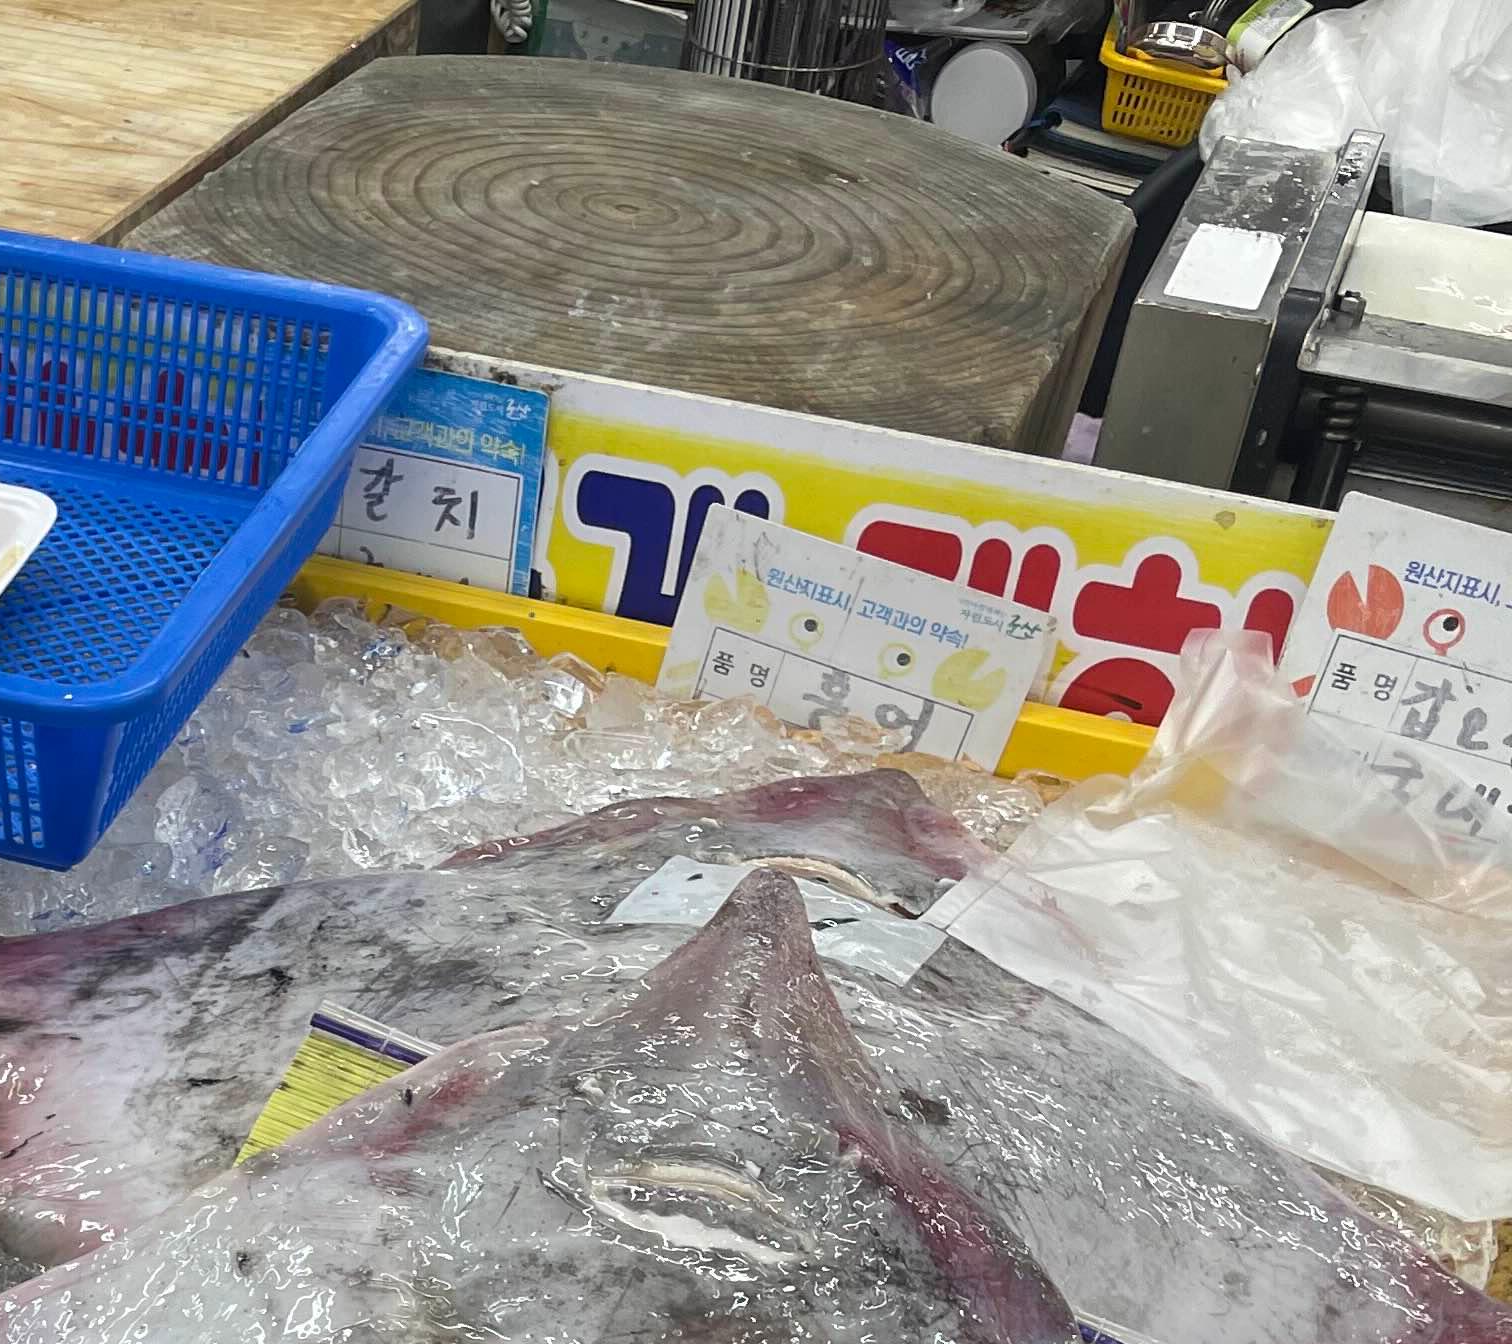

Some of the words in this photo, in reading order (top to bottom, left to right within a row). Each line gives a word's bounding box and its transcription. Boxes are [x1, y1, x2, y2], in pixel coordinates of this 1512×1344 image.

[359, 457, 479, 540] 갈치
[767, 567, 852, 613] 원산지표시,
[856, 598, 928, 635] 고객과의
[929, 620, 970, 649] 약속!
[1403, 561, 1501, 607] 원산지표시,
